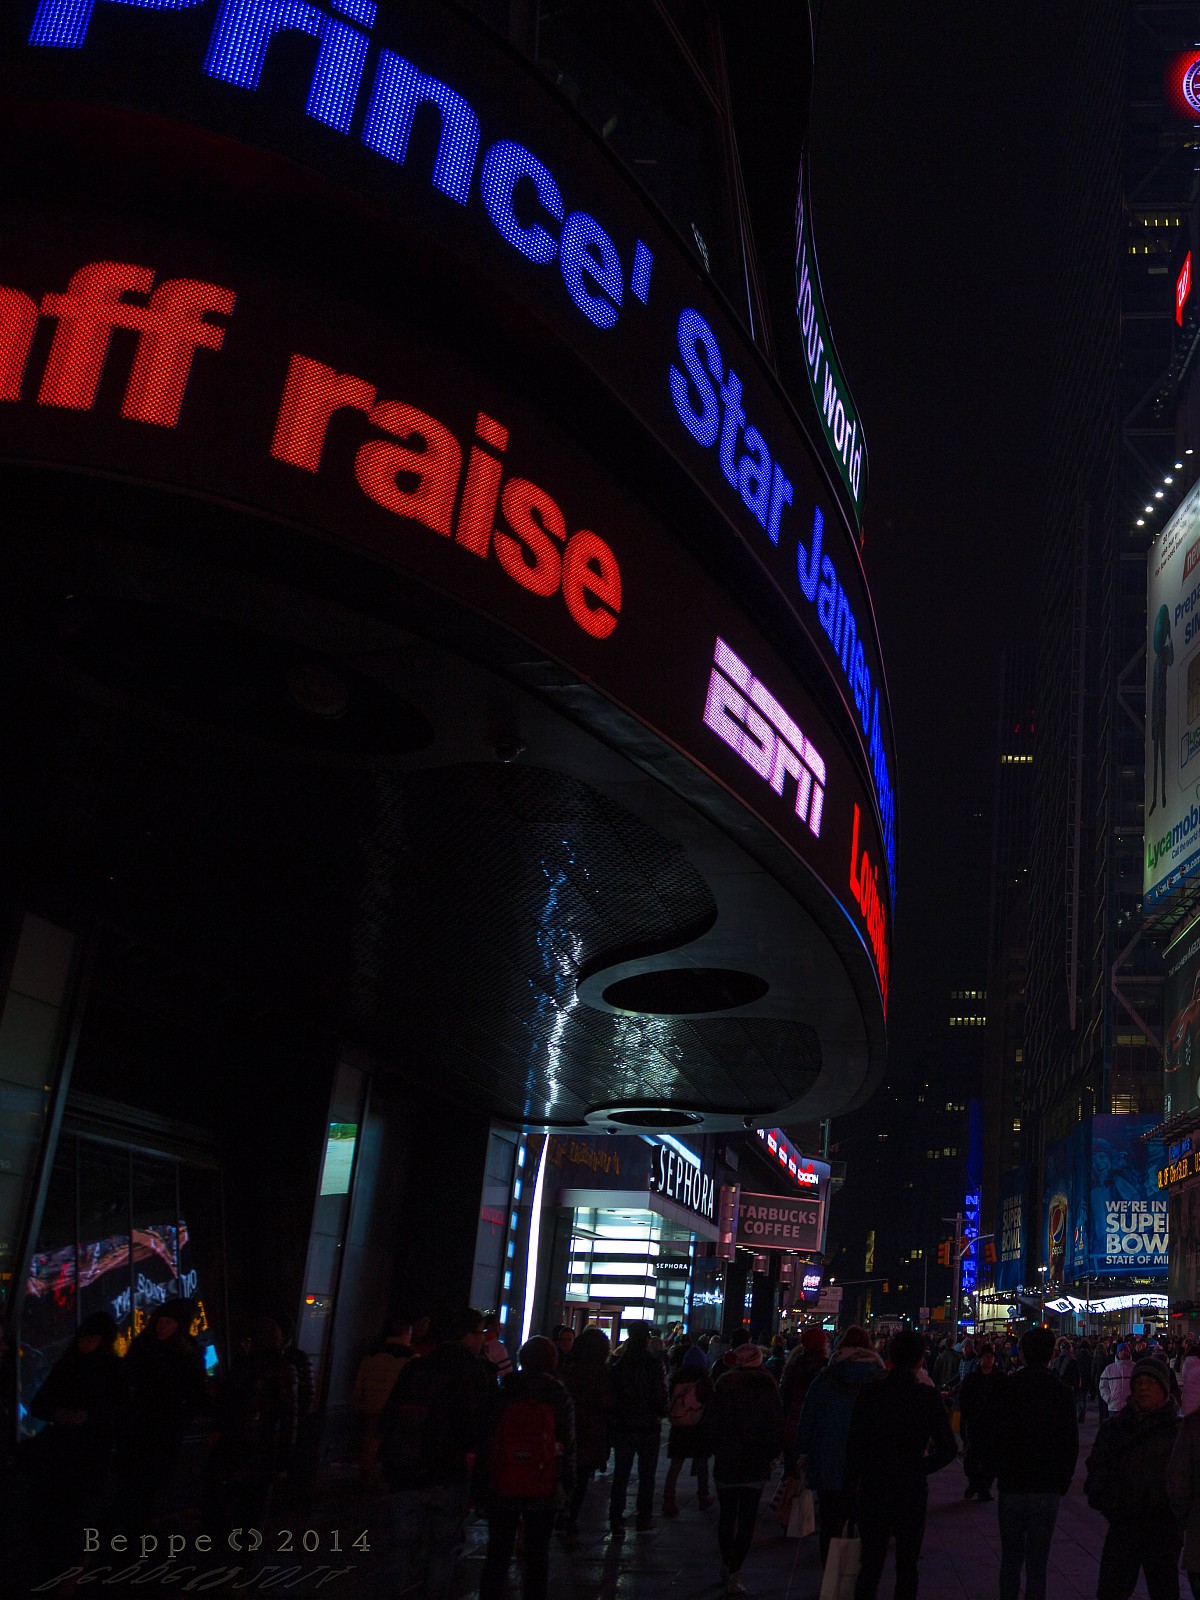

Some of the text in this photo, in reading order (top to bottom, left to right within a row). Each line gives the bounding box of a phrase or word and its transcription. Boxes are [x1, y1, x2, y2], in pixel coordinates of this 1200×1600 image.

[822, 360, 862, 503] world
[270, 352, 622, 640] raise
[670, 308, 793, 547] Star
[797, 506, 871, 736] James
[703, 635, 826, 839] ESPN
[657, 1144, 715, 1219] SEPHORA
[738, 1204, 817, 1225] TARBUCKS
[1106, 1201, 1167, 1212] WE'RE IN
[743, 1221, 801, 1238] COFFEE
[1106, 1213, 1169, 1233] SUPE
[1106, 1233, 1169, 1254] BOW
[1106, 1255, 1134, 1265] STATE
[1137, 1255, 1151, 1265] OF
